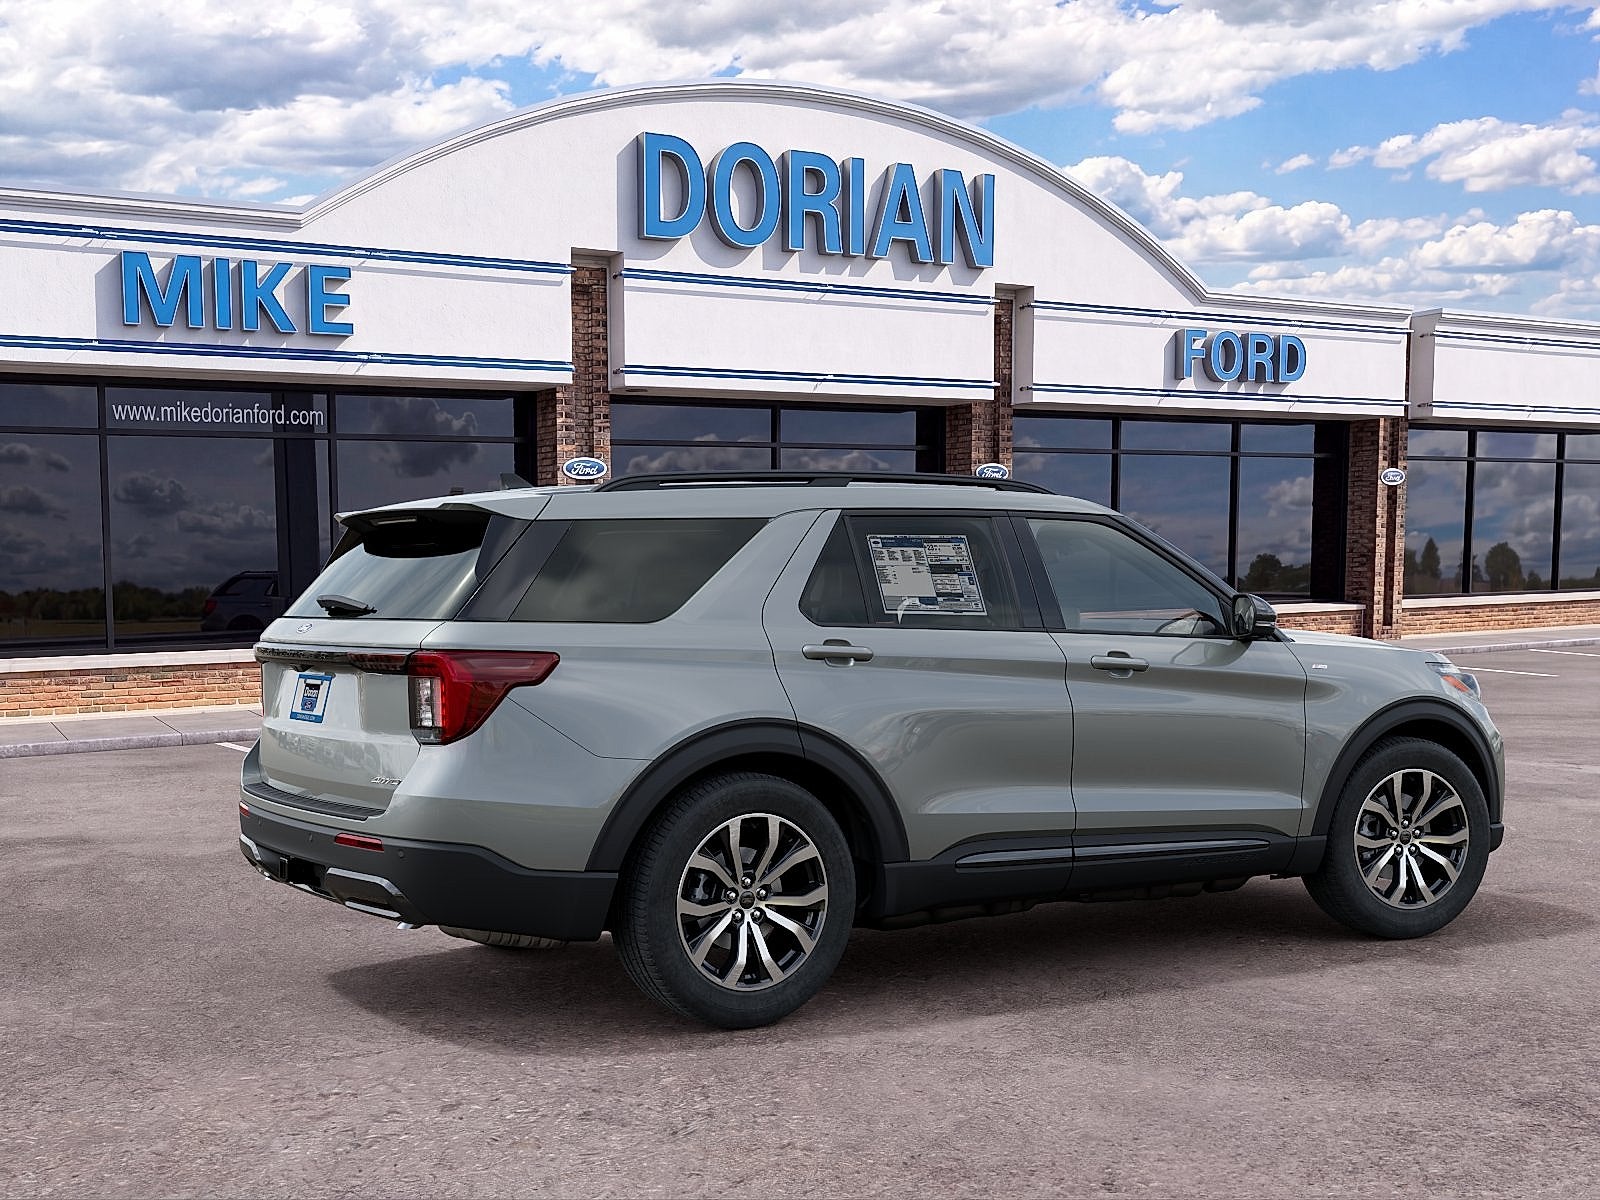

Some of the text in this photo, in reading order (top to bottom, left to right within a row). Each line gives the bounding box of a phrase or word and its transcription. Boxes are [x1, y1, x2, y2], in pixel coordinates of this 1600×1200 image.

[639, 132, 995, 268] DORIAN
[120, 250, 354, 337] MIKE
[1178, 328, 1308, 382] FORD
[112, 401, 325, 426] www.mikedorianford.com
[571, 461, 599, 475] Ford
